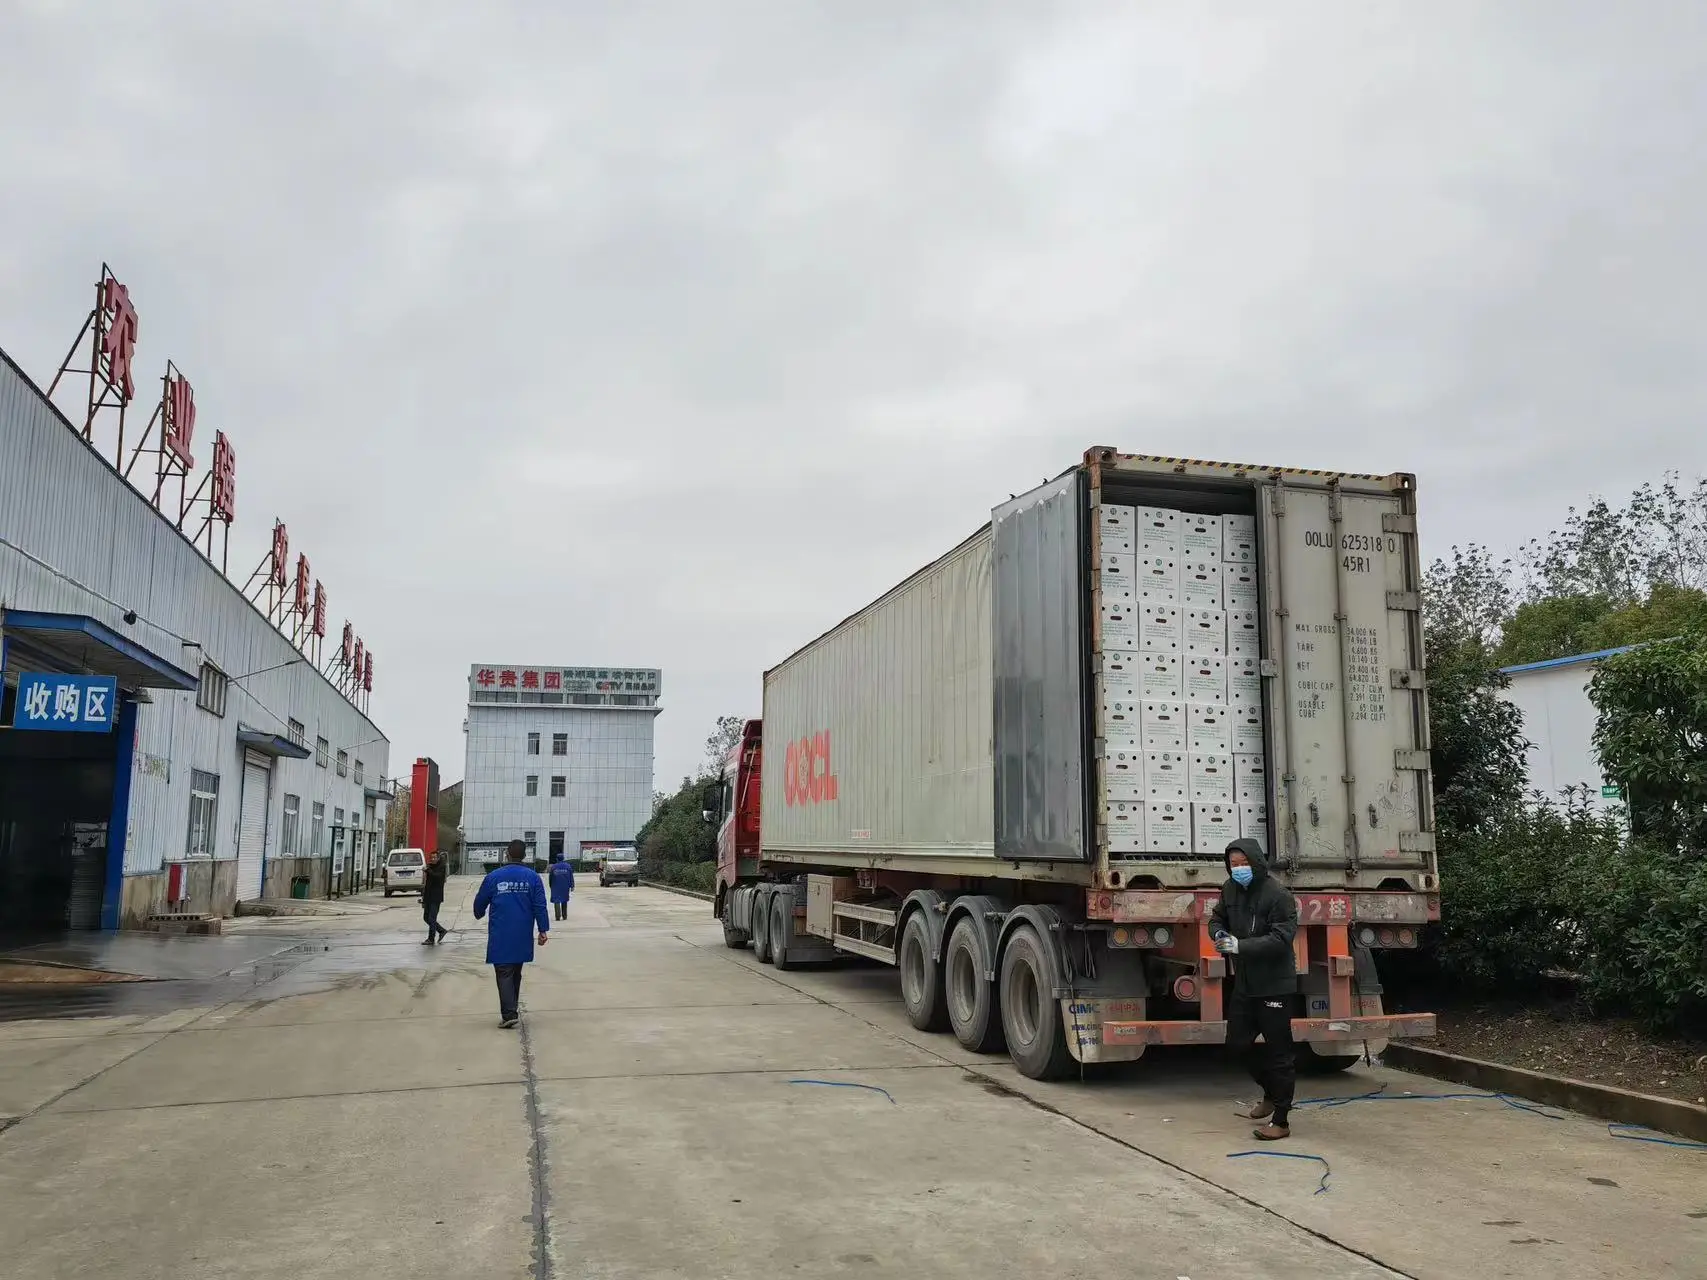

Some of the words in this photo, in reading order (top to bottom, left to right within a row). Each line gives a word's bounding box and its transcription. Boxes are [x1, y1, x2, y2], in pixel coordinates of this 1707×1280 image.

[1305, 531, 1333, 548] OOLU
[1341, 534, 1383, 552] 625318
[1388, 538, 1395, 553] 0
[1343, 556, 1370, 572] 45R1
[1314, 625, 1336, 634] GROSS
[1297, 643, 1314, 652] TARE
[1297, 662, 1310, 671] NET
[476, 668, 561, 690] 华贵集团
[1298, 681, 1317, 690] CUBIC
[24, 682, 108, 722] 收购区
[1298, 701, 1325, 709] USABLE
[1299, 709, 1316, 718] CUBE
[784, 728, 838, 808] OOCL
[1068, 1003, 1100, 1014] CIMC
